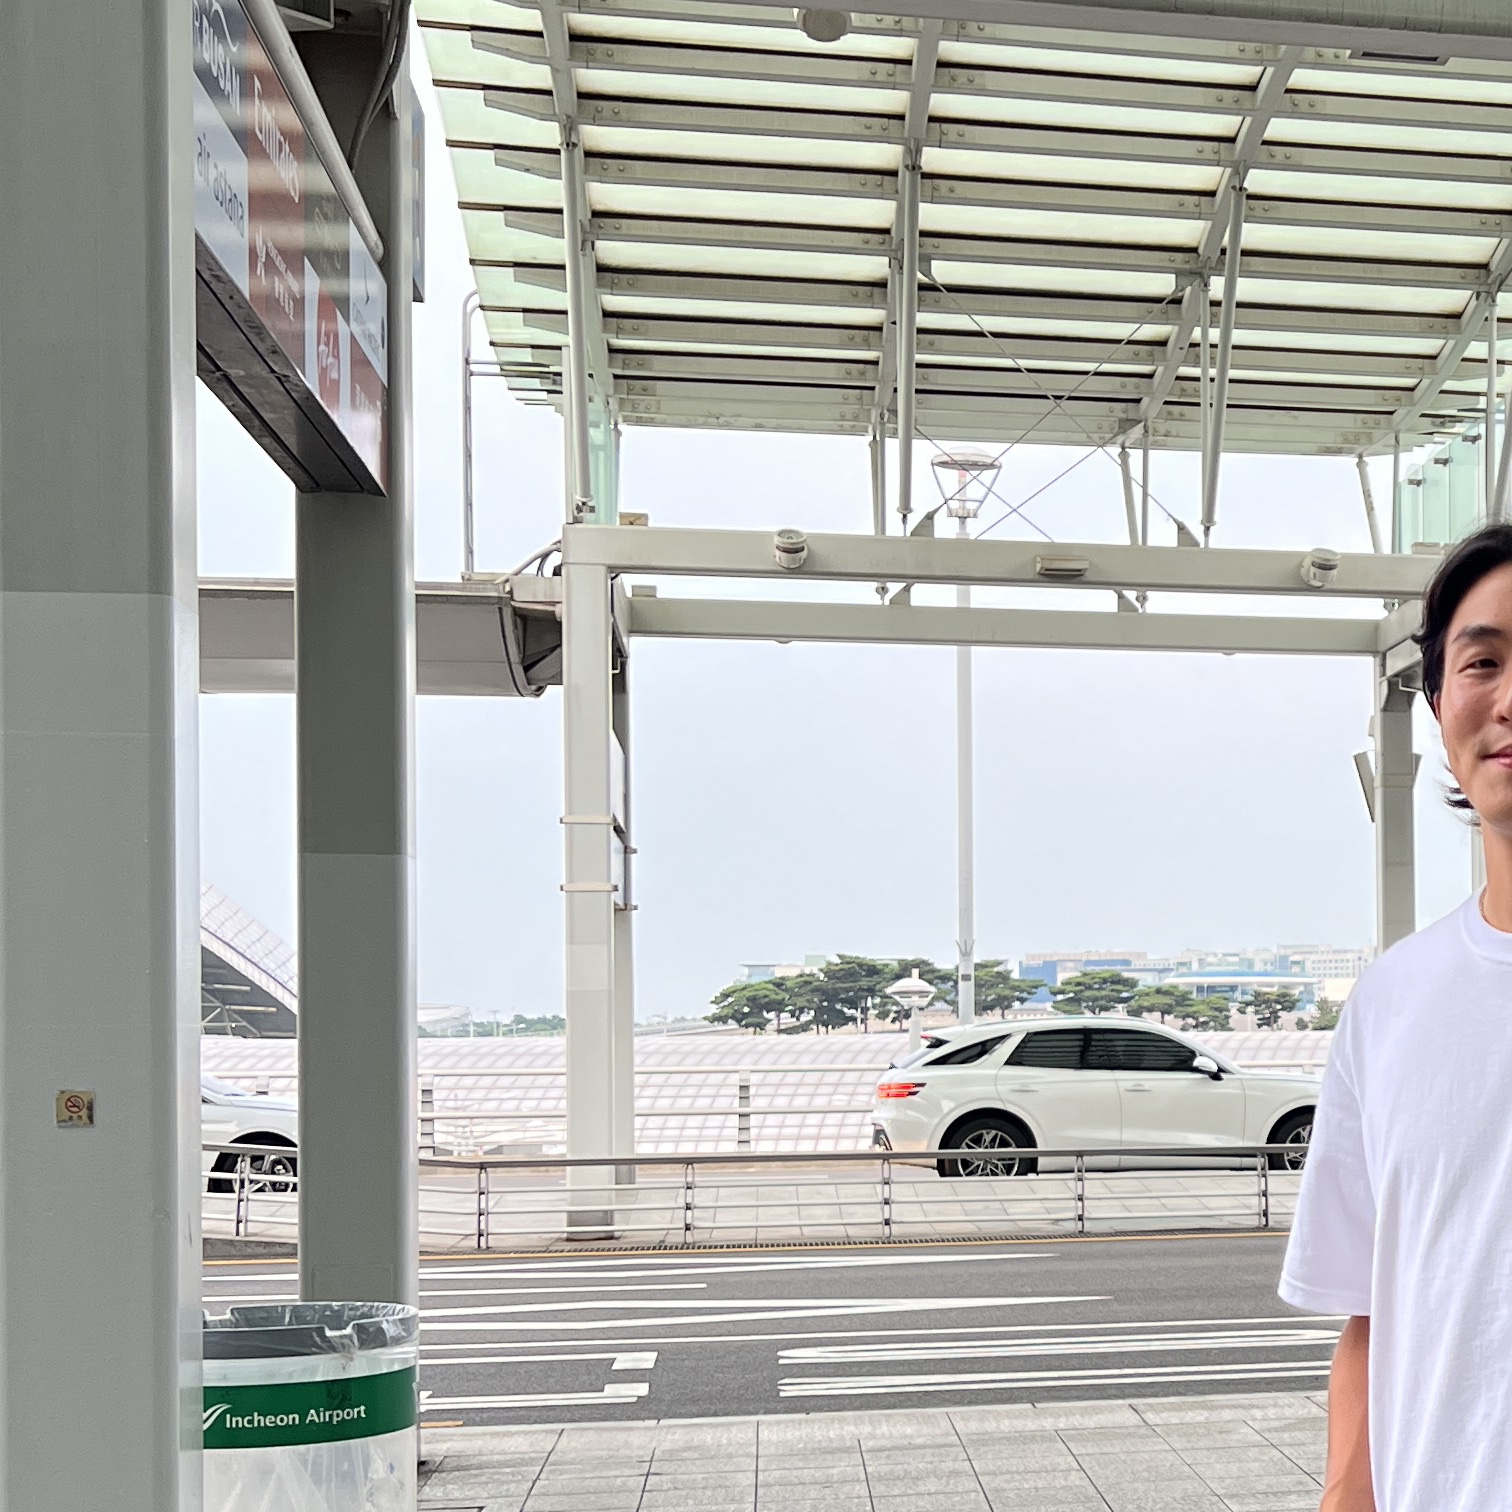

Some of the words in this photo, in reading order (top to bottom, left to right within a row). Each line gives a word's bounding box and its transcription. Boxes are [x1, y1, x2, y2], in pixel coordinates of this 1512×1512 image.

[202, 13, 241, 117] BUSAN
[197, 132, 211, 188] air
[213, 162, 244, 239] astana
[254, 73, 299, 204] Emirates
[225, 1411, 300, 1429] Incheon
[305, 1404, 367, 1425] Airport
